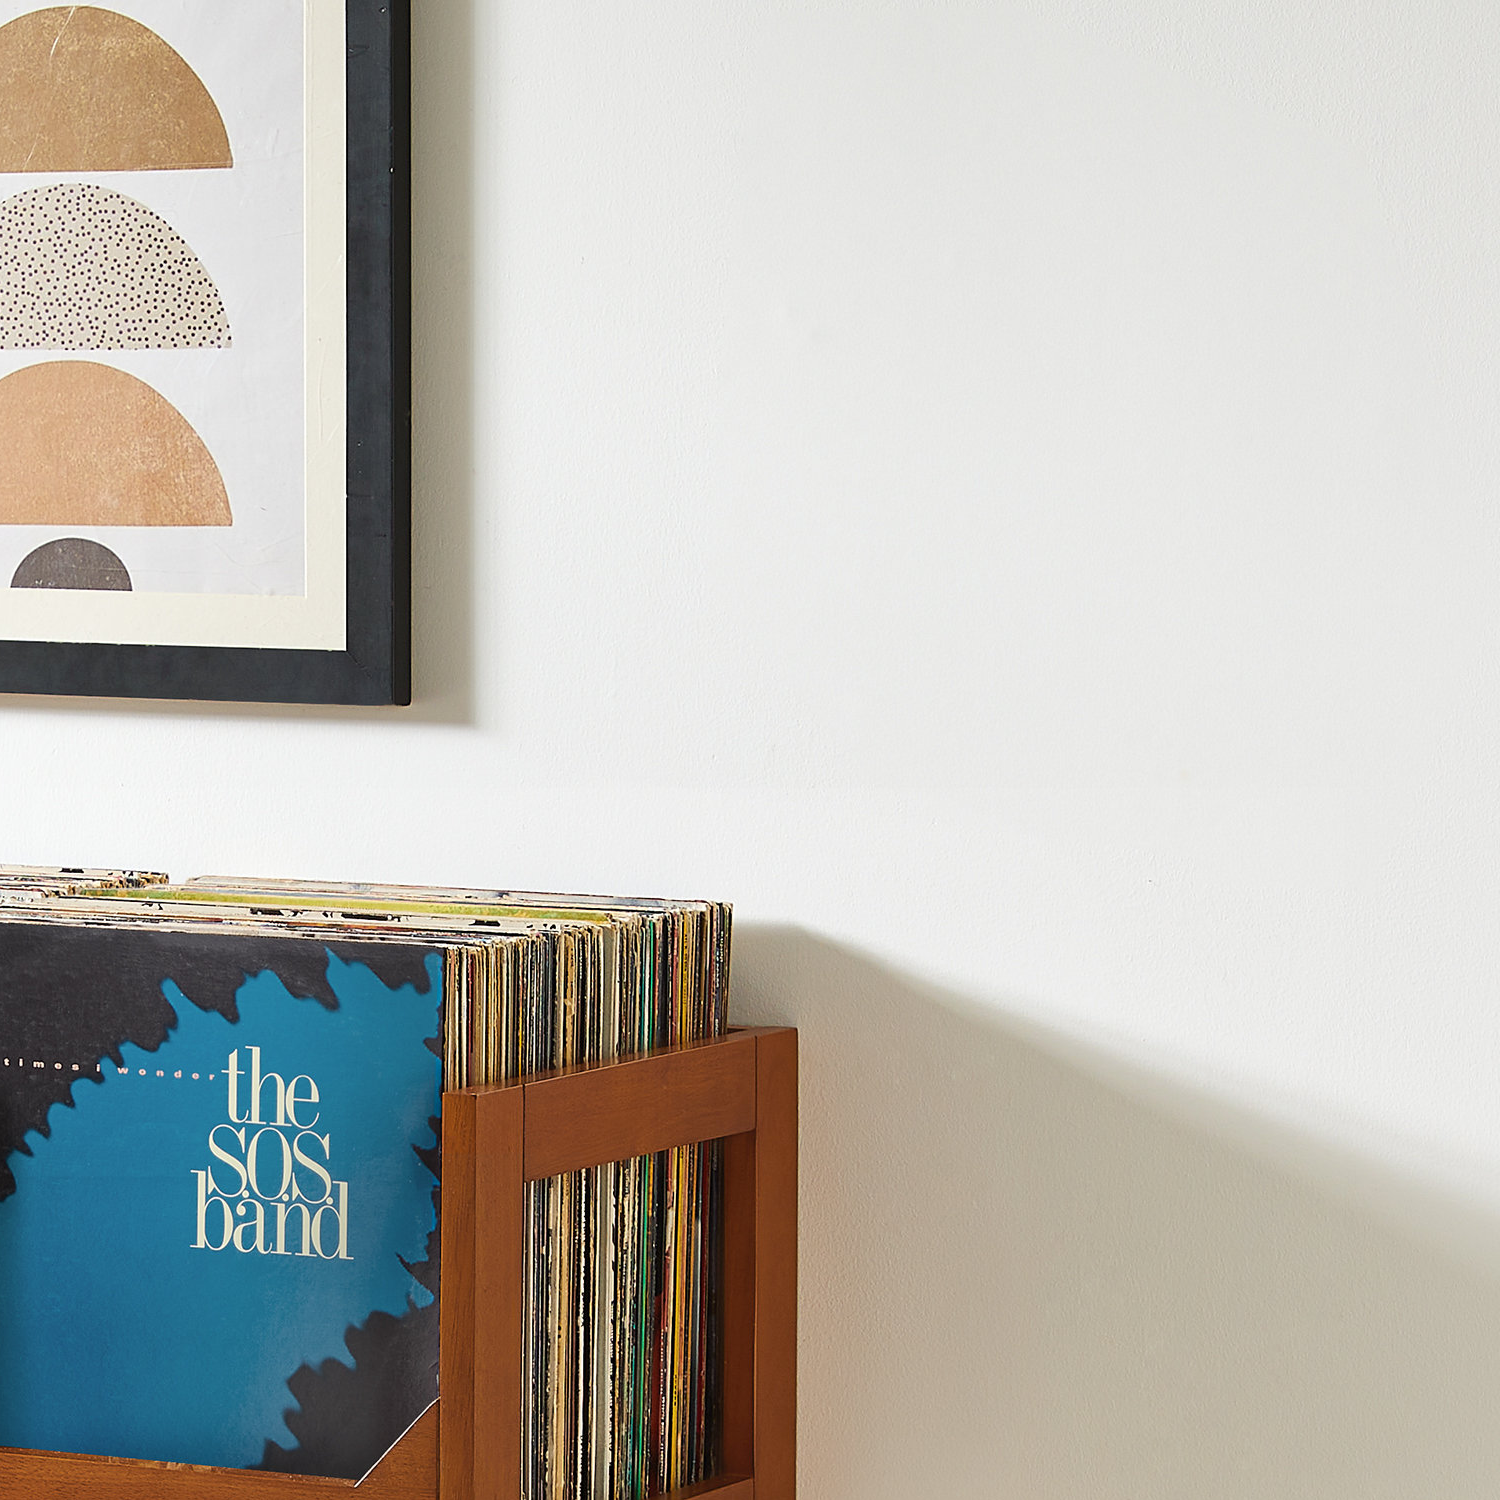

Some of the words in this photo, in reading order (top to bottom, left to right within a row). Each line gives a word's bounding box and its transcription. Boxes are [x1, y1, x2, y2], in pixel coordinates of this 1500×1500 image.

[117, 1065, 215, 1081] wonder
[221, 1045, 320, 1129] the
[208, 1123, 334, 1205] S.O.S.
[189, 1169, 354, 1260] band
